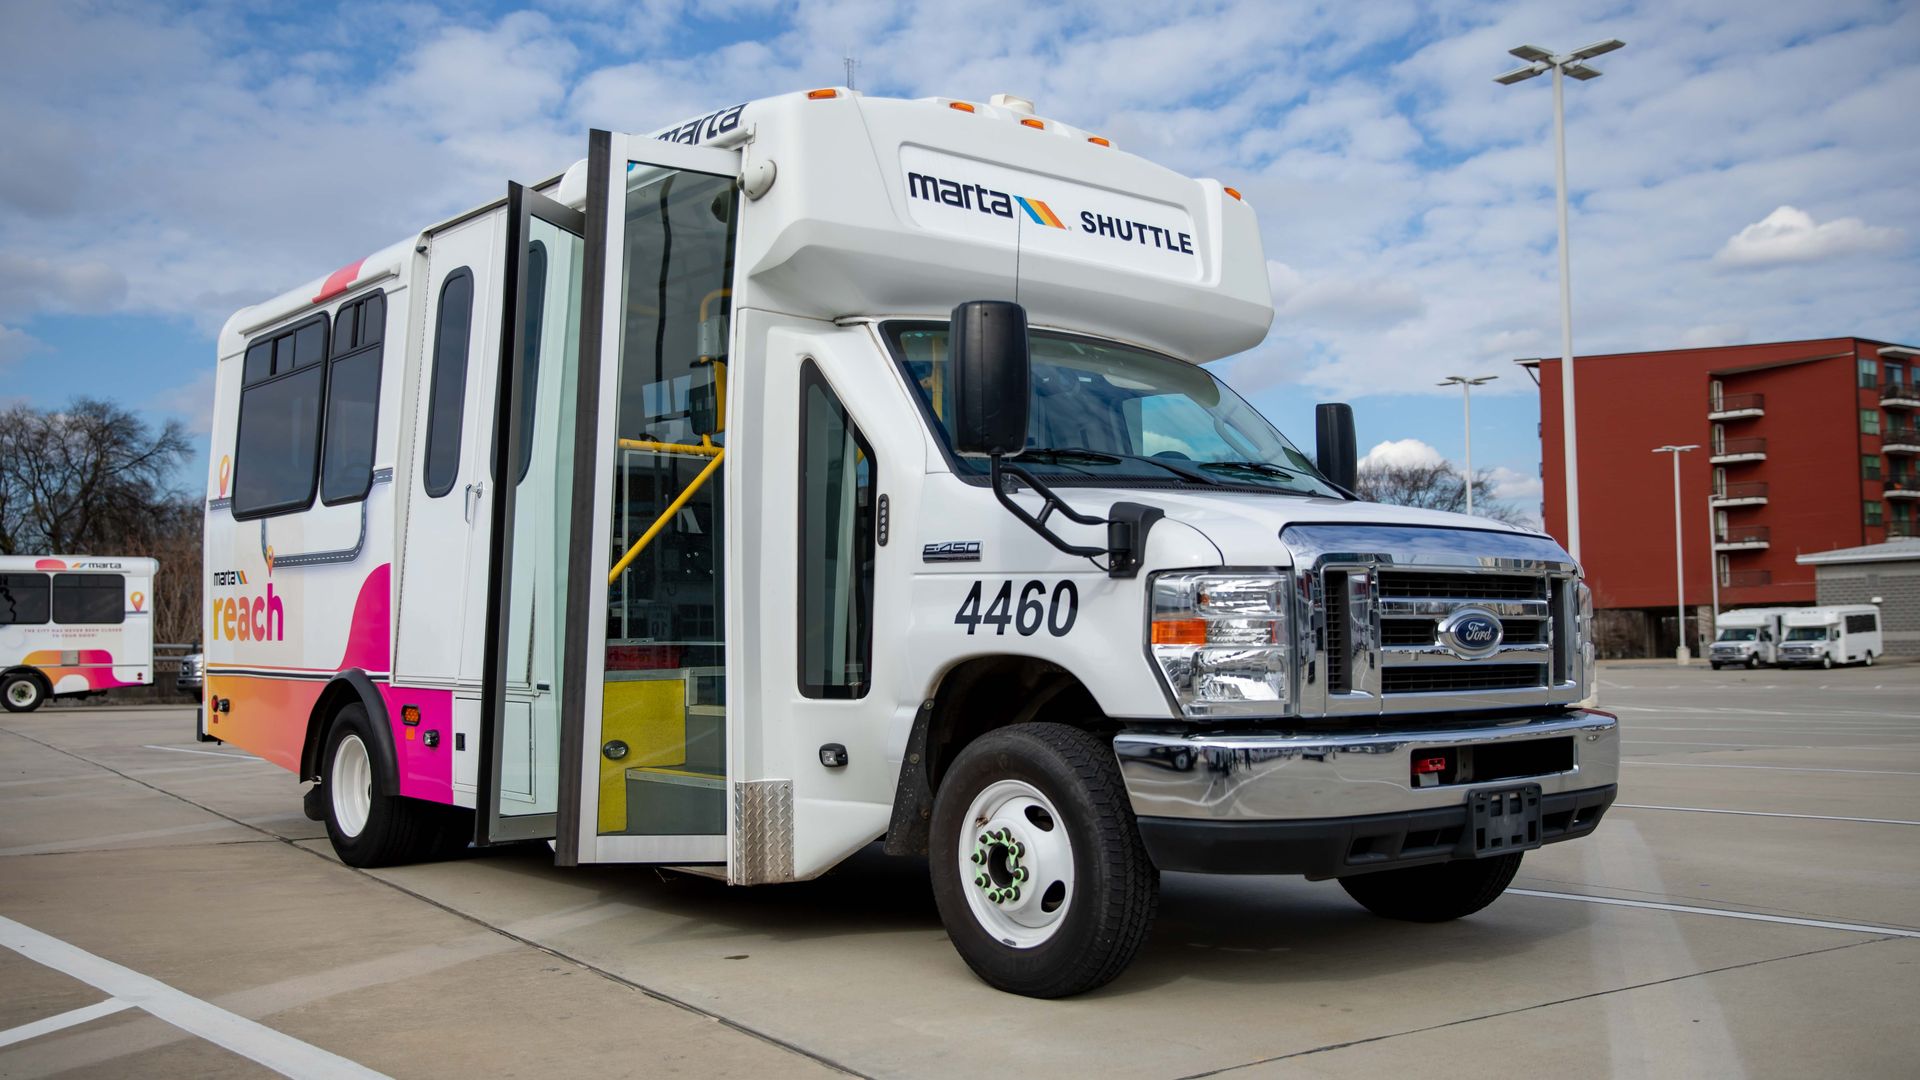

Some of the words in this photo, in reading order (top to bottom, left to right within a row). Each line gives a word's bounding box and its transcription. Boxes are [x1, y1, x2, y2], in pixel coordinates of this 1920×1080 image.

[908, 171, 1014, 219] marta
[1080, 210, 1194, 255] SHUTTLE
[213, 569, 236, 586] marta
[213, 582, 284, 642] reach
[954, 579, 1079, 637] 4460
[1465, 621, 1492, 641] Ford
